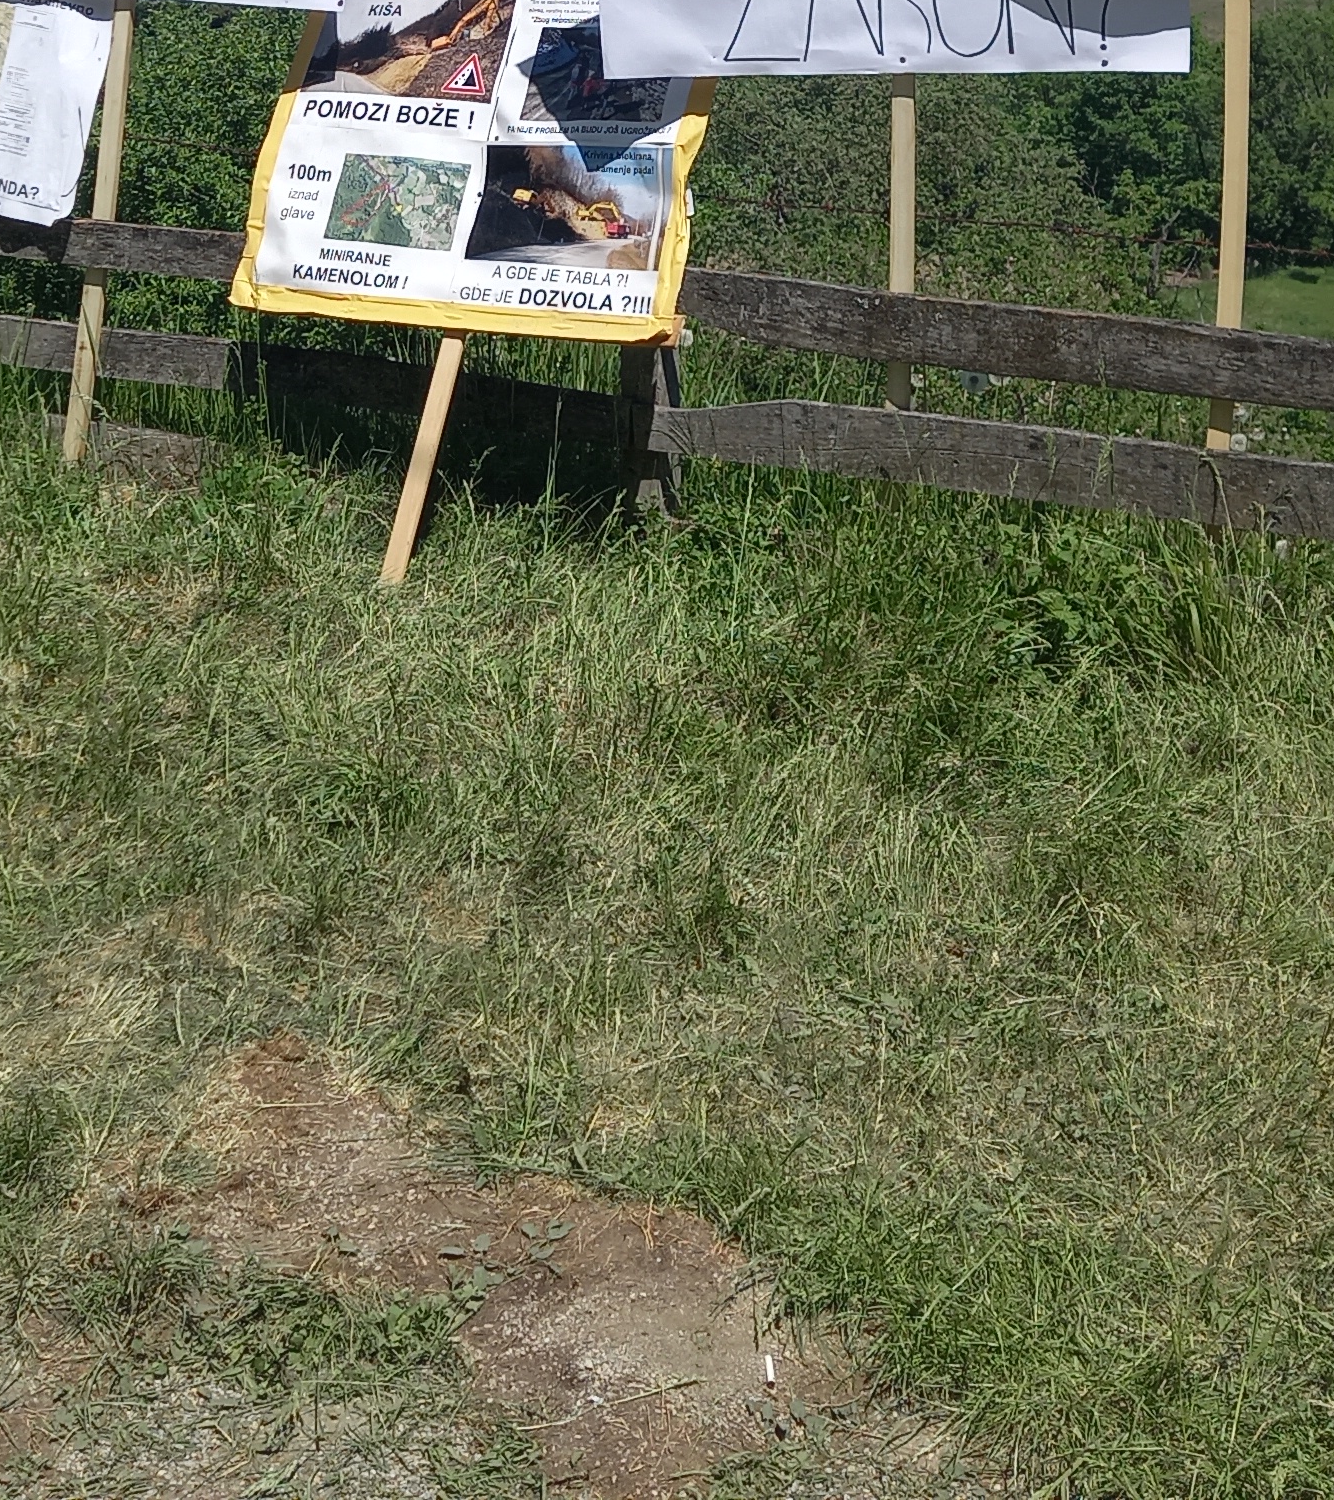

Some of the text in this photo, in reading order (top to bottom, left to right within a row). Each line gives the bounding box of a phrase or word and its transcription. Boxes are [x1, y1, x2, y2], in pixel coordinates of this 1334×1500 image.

[368, 2, 402, 17] KIŠA
[303, 100, 390, 122] POMOZI
[396, 103, 460, 128] BOŽE
[581, 126, 603, 134] BUDU
[584, 150, 613, 160] Krivina
[288, 163, 332, 182] 100m
[633, 164, 655, 176] pada!
[288, 188, 319, 201] iznad
[280, 206, 315, 221] glave
[319, 248, 392, 267] MINIRANJE
[292, 264, 399, 289] KAMENOLOM
[492, 265, 501, 278] A
[506, 266, 537, 280] GDE
[542, 269, 560, 282] JE
[566, 270, 611, 286] TABLA
[460, 287, 492, 302] GDE
[495, 290, 514, 303] JE
[519, 288, 612, 311] DOZVOLA
